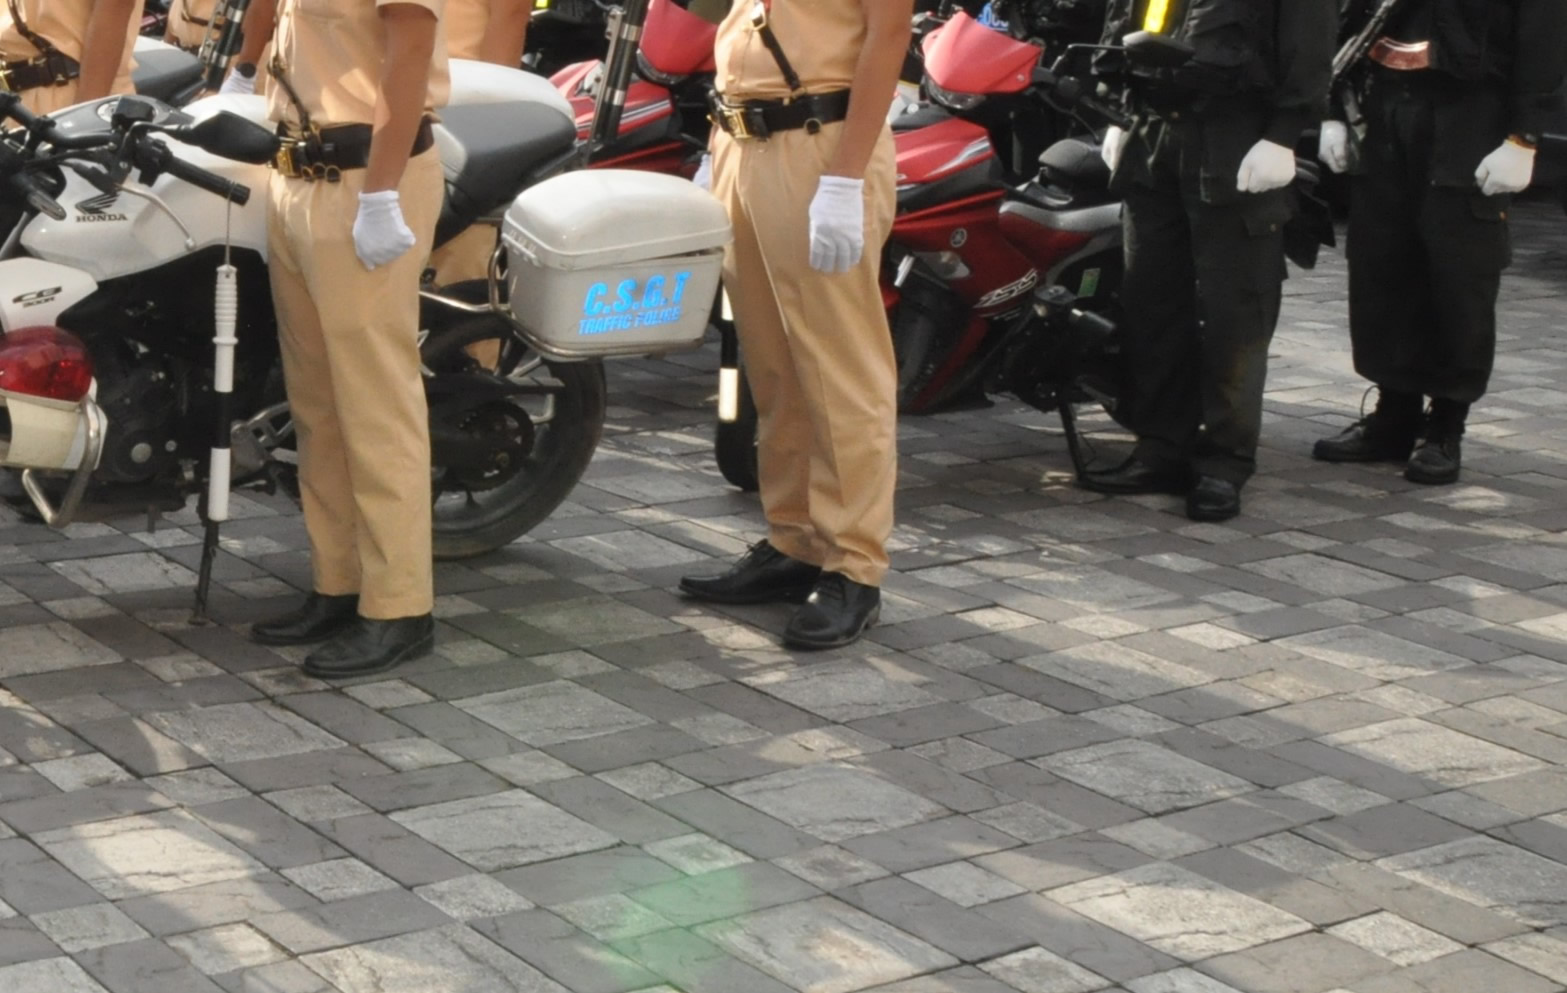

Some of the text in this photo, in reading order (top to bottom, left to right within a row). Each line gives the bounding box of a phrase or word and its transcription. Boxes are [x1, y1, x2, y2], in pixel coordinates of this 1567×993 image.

[76, 213, 128, 223] HONDA
[584, 271, 692, 316] C.S.G.T
[578, 314, 632, 336] TRAFFIC
